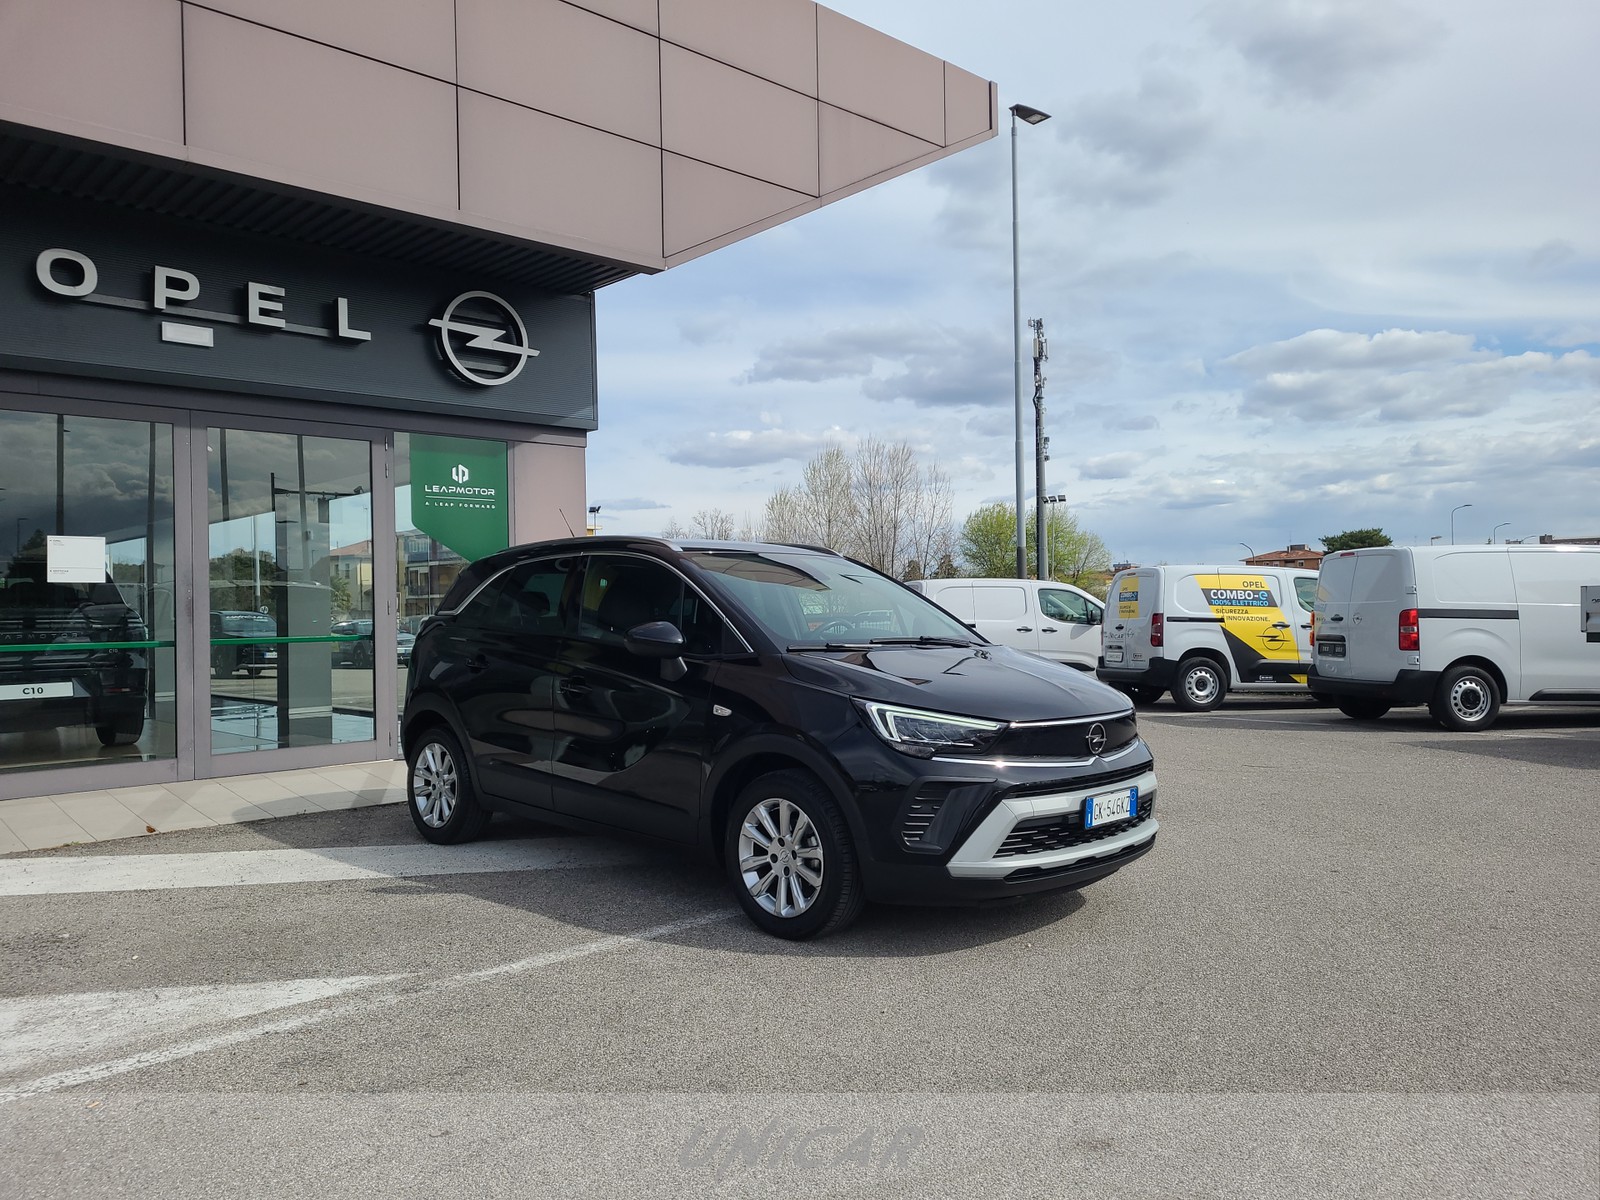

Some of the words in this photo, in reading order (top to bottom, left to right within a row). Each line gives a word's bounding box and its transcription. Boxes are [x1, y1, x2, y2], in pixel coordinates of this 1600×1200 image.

[36, 247, 372, 342] OPEL
[424, 484, 495, 496] LEAPMOTOR
[1242, 580, 1265, 589] OPEL
[1210, 589, 1269, 600] COMBO-e
[4, 632, 78, 640] APMOTOR
[22, 687, 44, 695] C10
